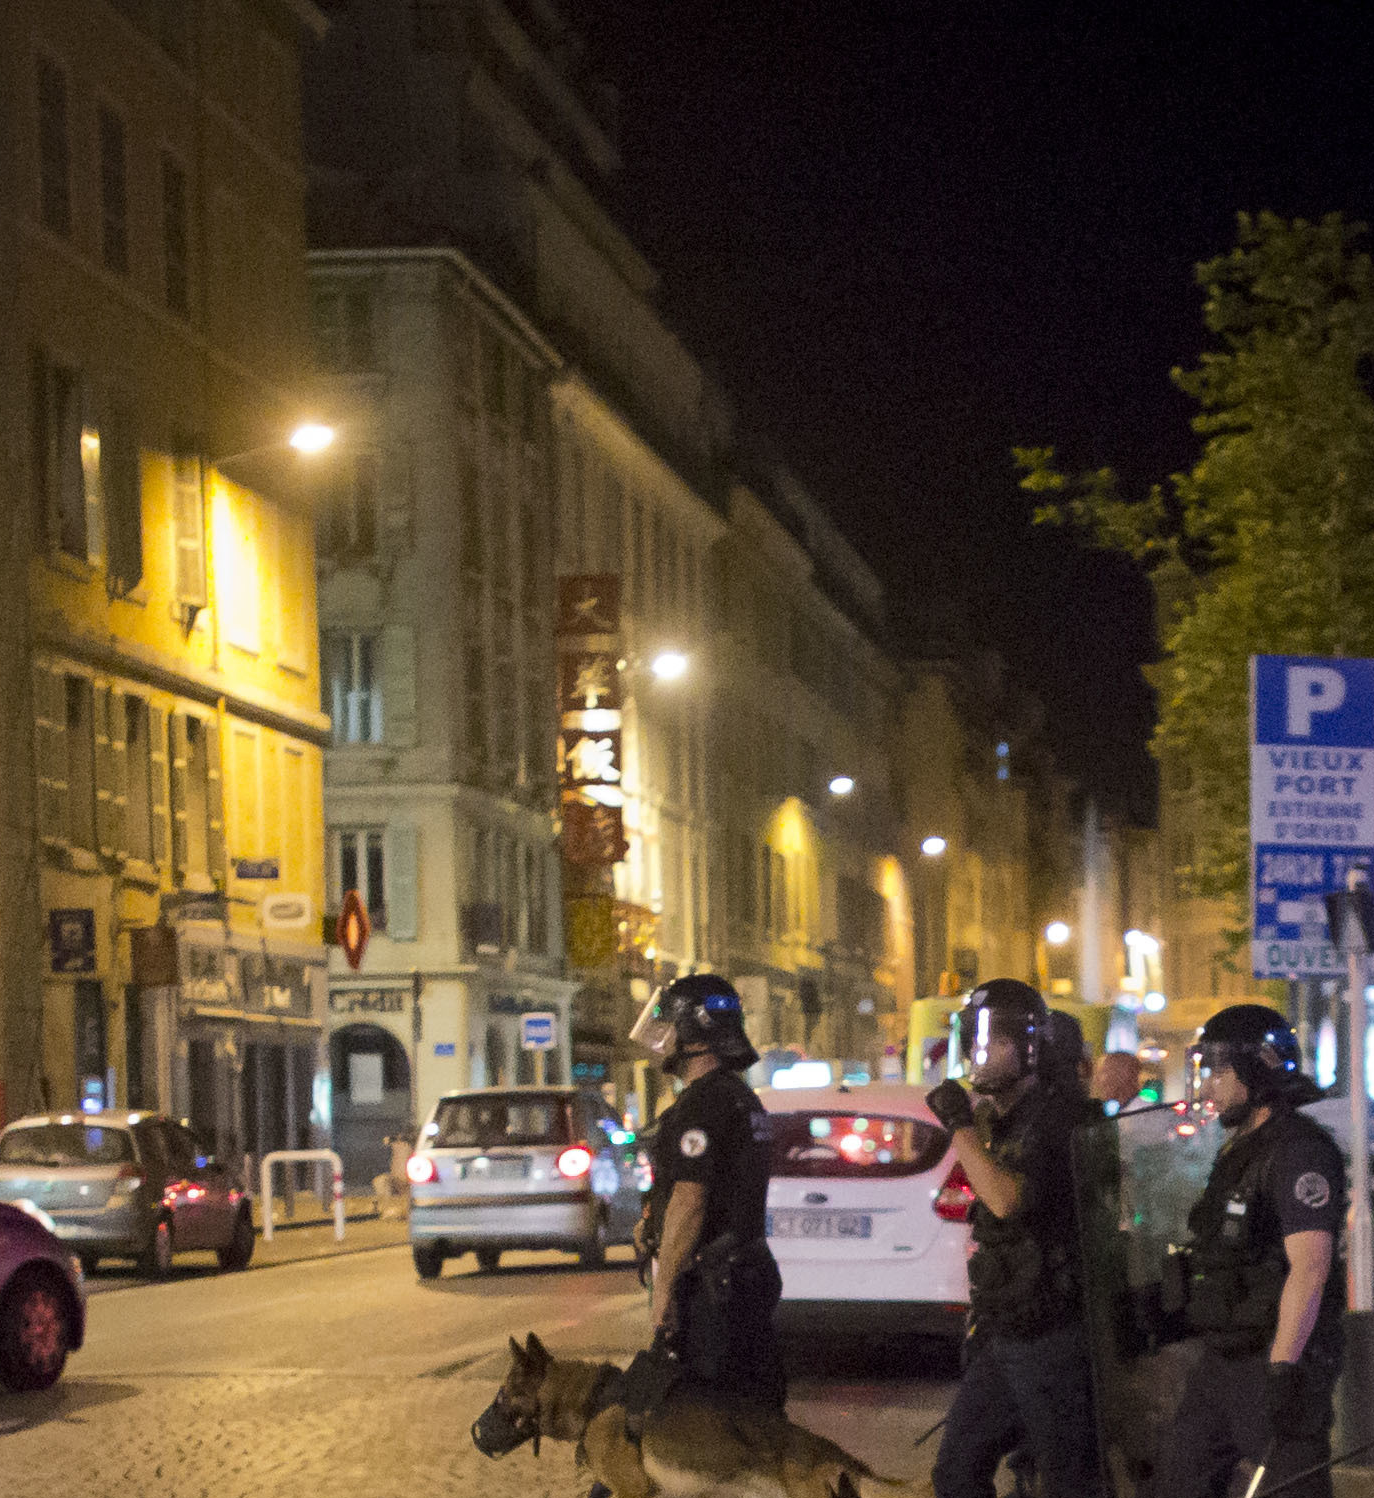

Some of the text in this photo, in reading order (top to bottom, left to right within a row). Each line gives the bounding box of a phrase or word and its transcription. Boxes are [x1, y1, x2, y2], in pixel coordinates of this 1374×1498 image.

[1286, 665, 1347, 737] P
[1269, 750, 1365, 771] VIEUX
[1274, 774, 1358, 796] PORT
